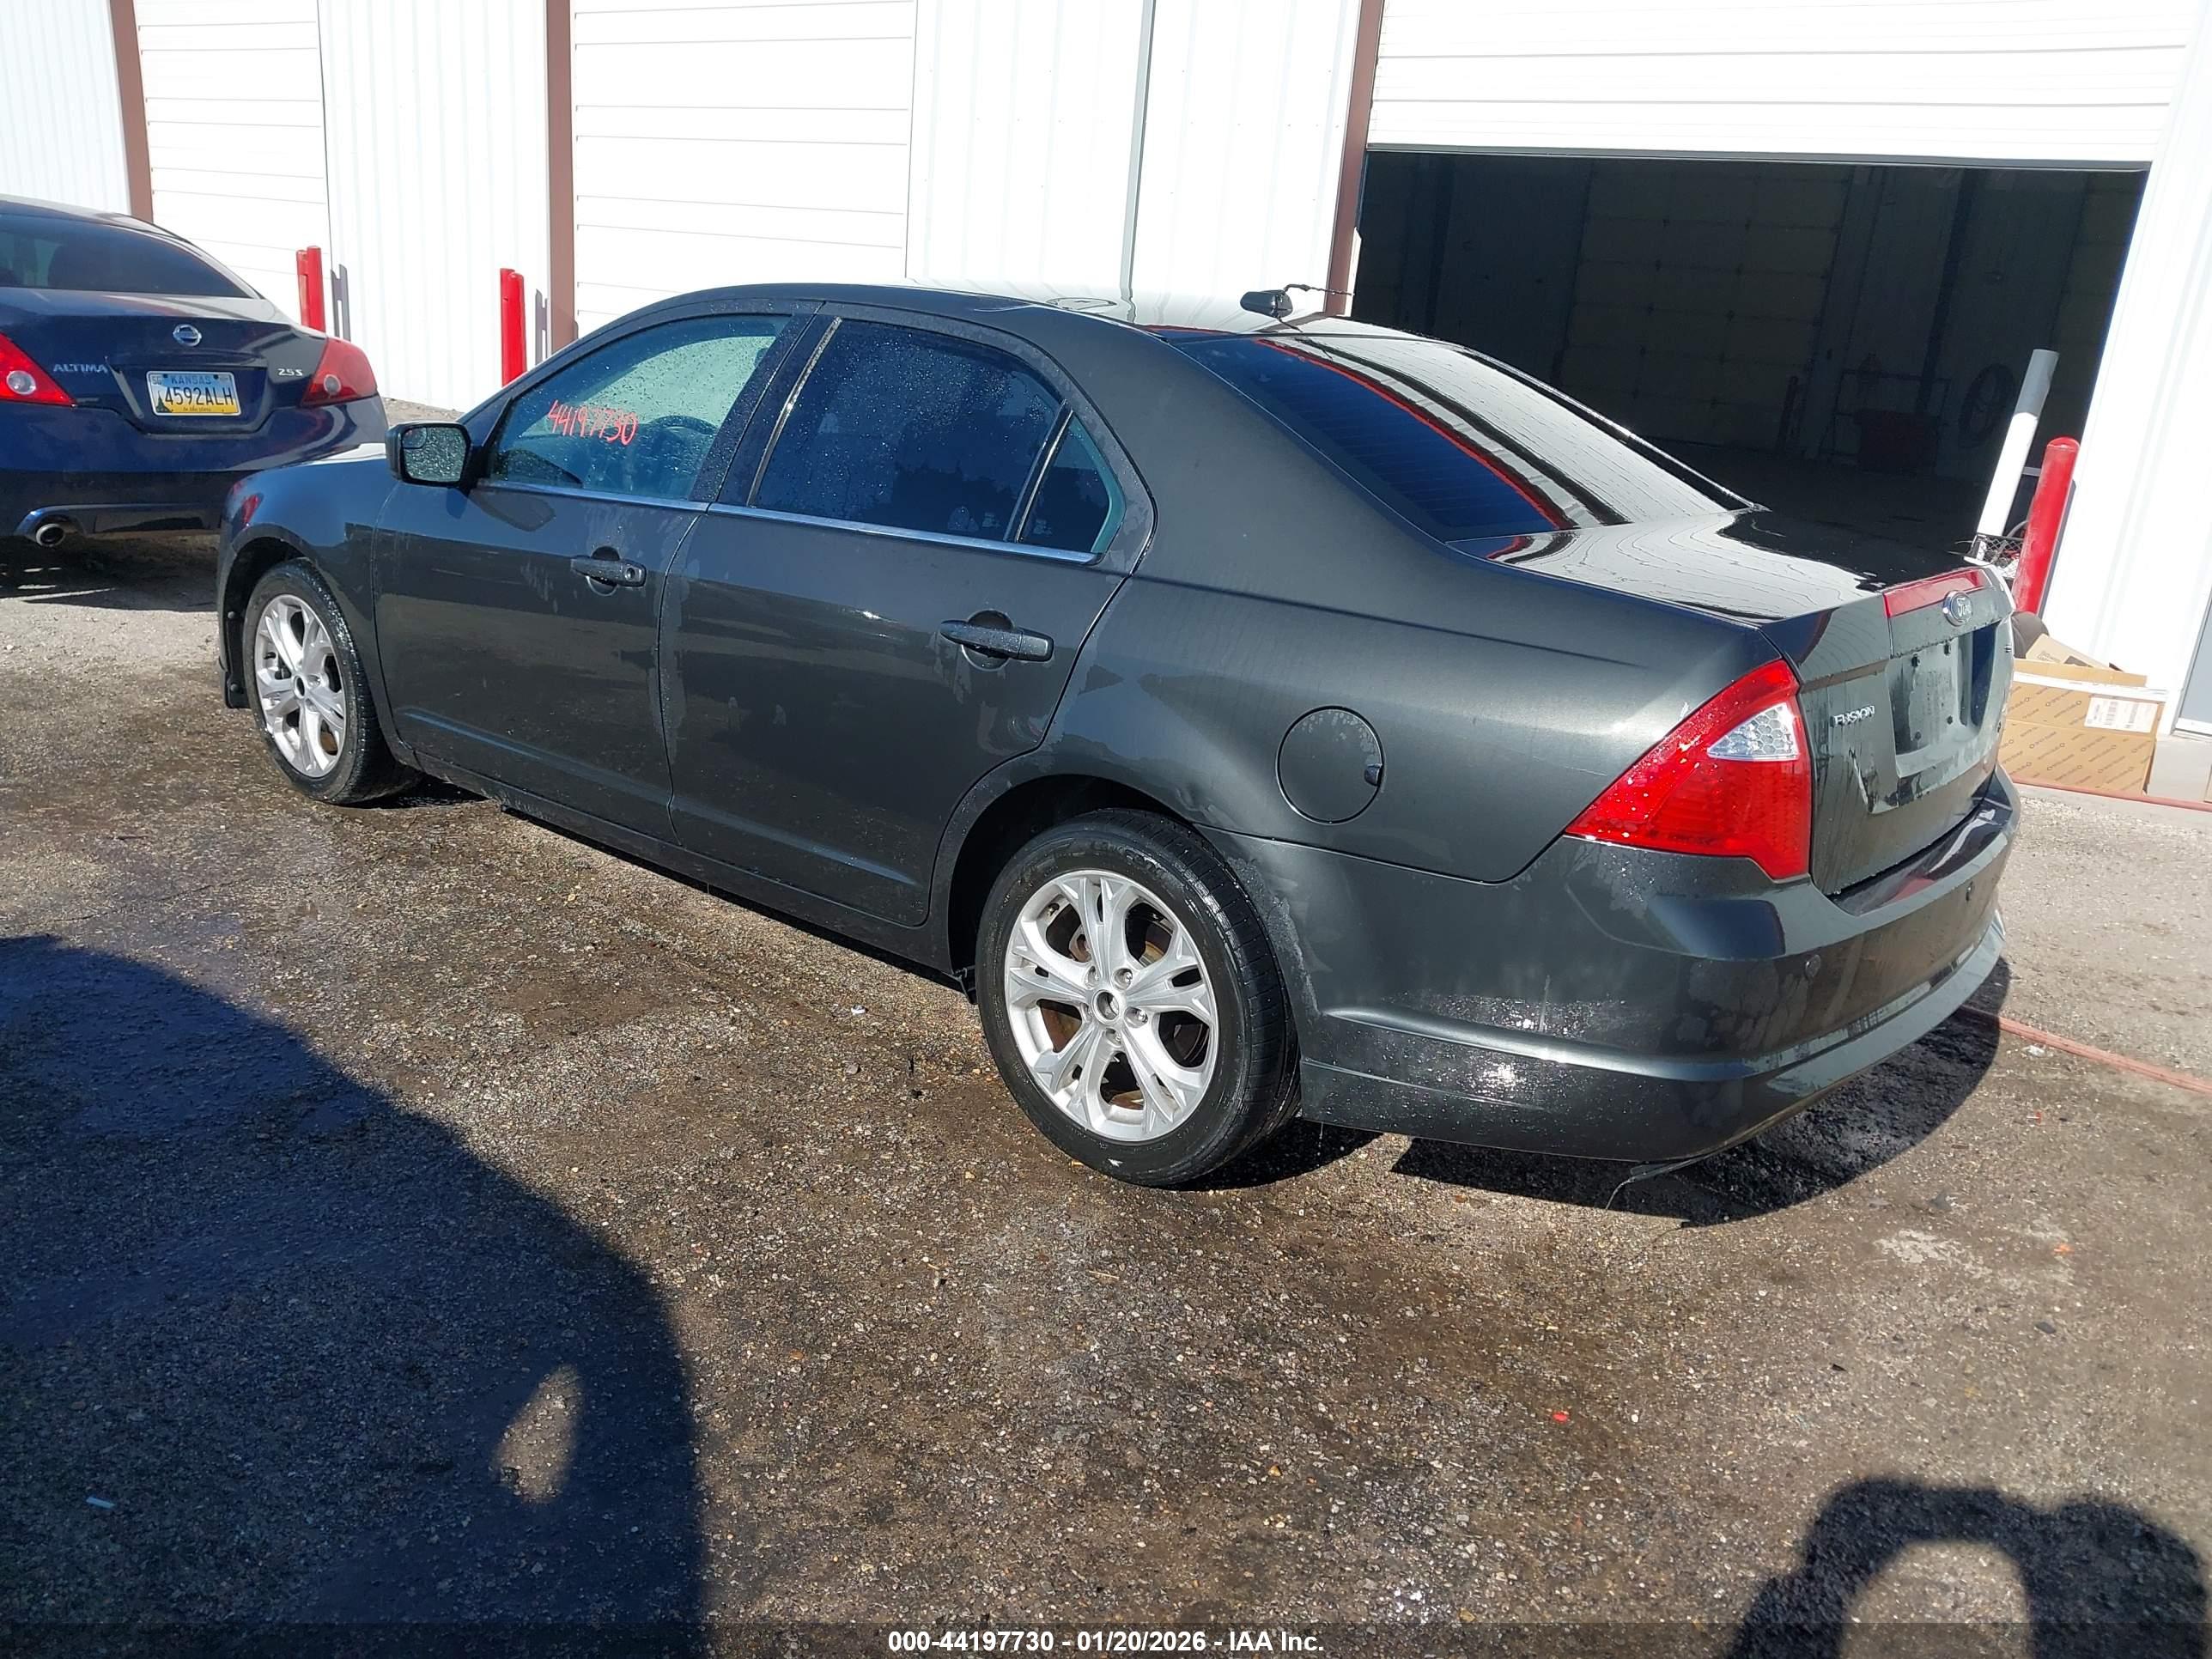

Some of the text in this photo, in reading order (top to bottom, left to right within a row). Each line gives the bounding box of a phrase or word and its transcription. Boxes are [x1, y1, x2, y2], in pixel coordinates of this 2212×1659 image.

[53, 363, 108, 374] ALTIMA
[172, 375, 212, 385] KANSAS
[165, 386, 234, 405] 4592ALH
[547, 399, 639, 445] 44197730
[1833, 705, 1875, 725] FUSION
